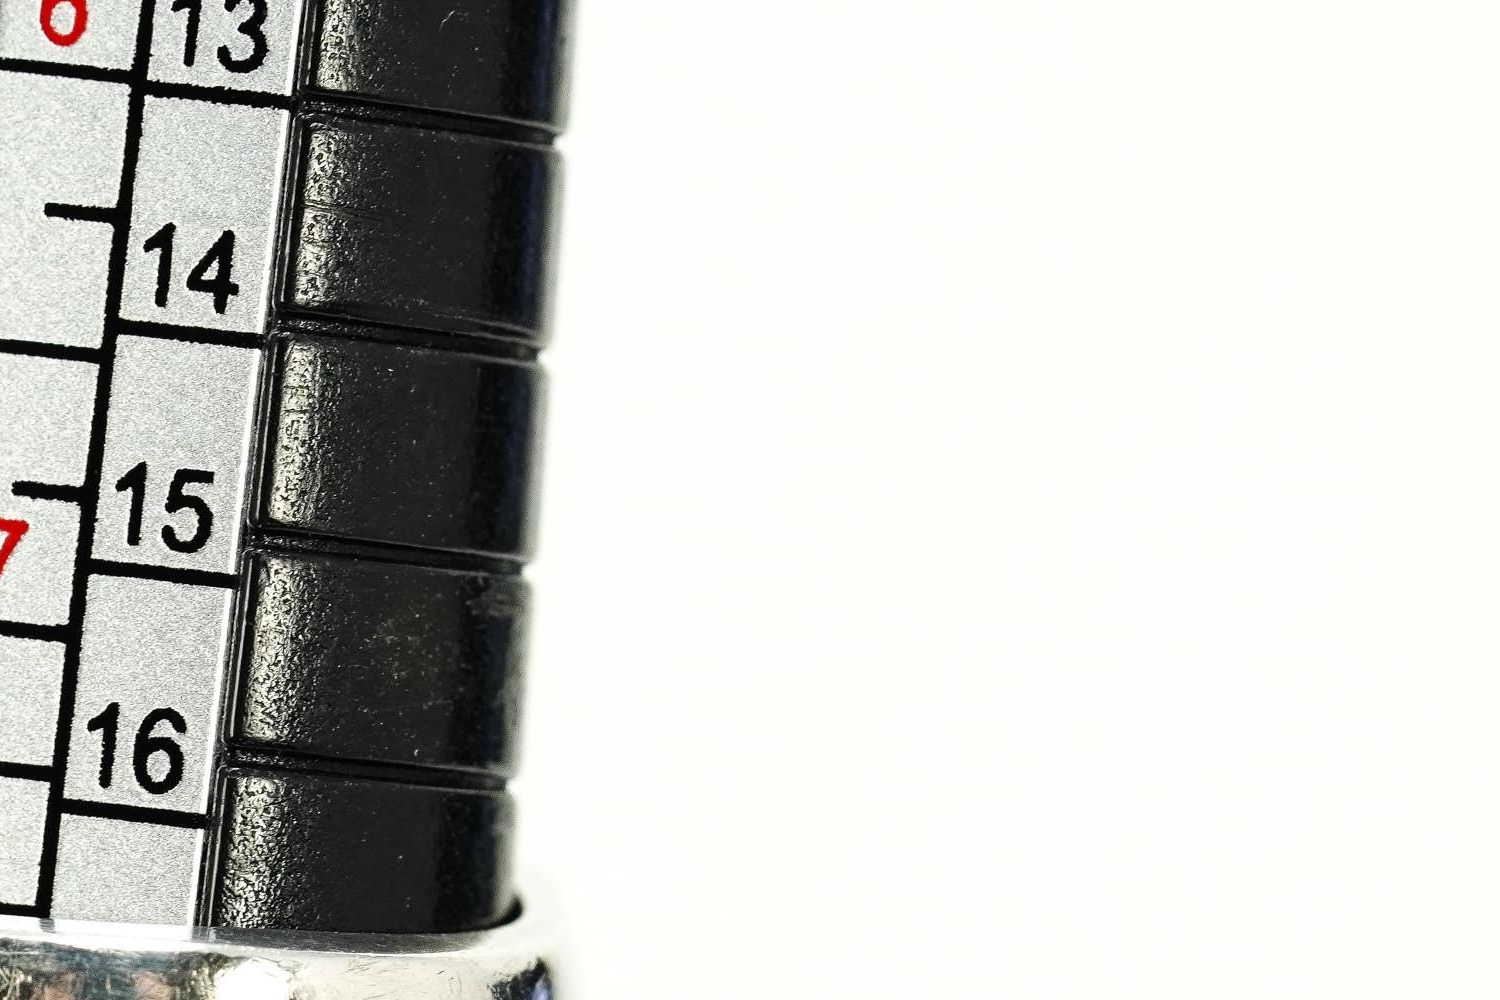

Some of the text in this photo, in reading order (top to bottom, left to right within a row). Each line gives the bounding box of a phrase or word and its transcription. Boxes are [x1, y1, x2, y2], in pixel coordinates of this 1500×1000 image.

[171, 0, 271, 74] 13
[143, 222, 240, 316] 14
[115, 461, 215, 555] 15
[87, 702, 188, 795] 16
